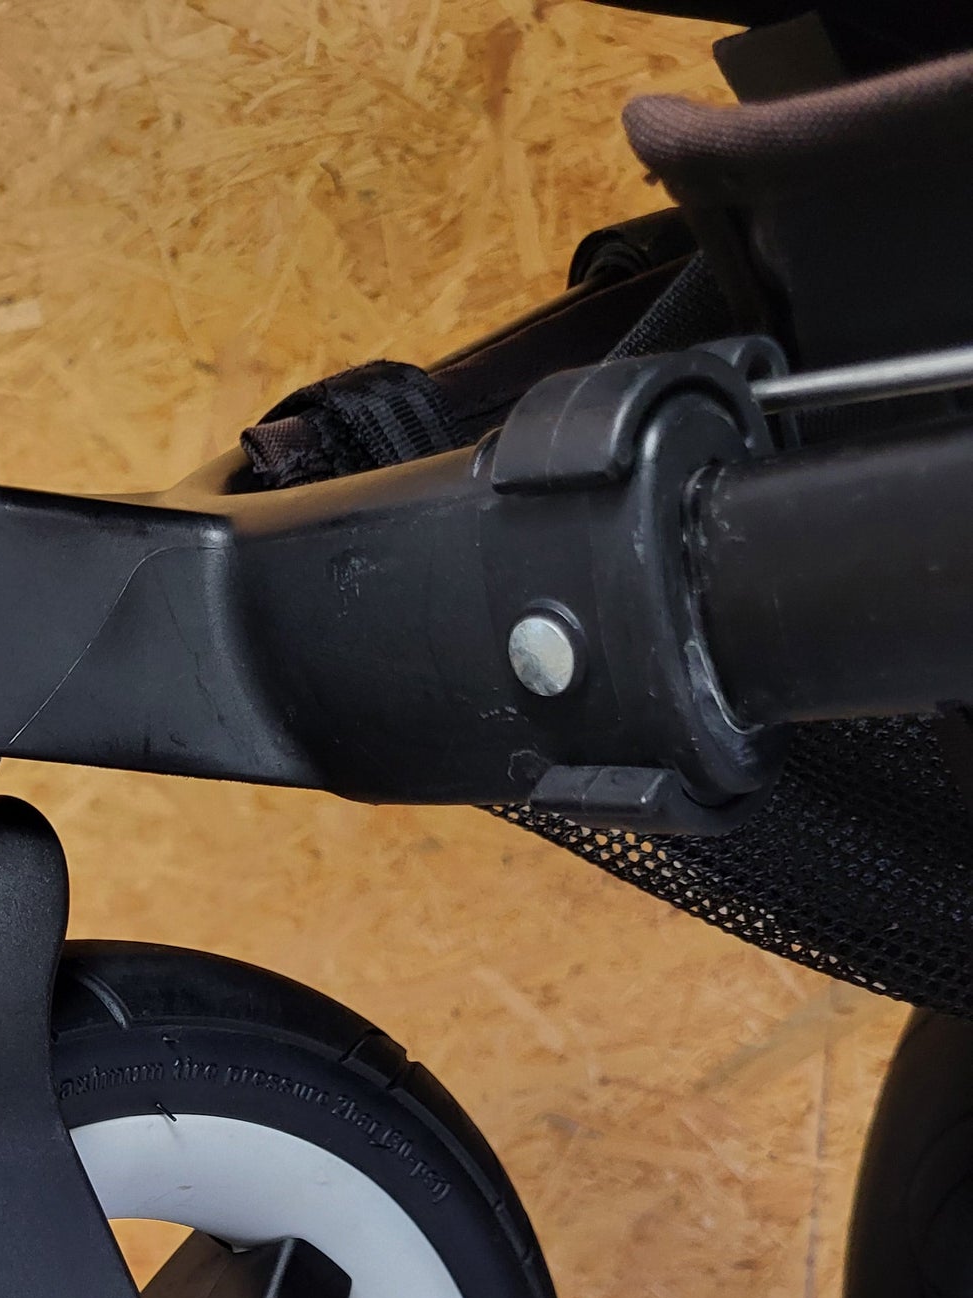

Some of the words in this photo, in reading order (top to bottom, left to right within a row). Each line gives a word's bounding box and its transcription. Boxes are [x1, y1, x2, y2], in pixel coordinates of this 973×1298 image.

[55, 1062, 164, 1101] aximum
[172, 1055, 219, 1082] tire
[224, 1064, 331, 1106] pressure
